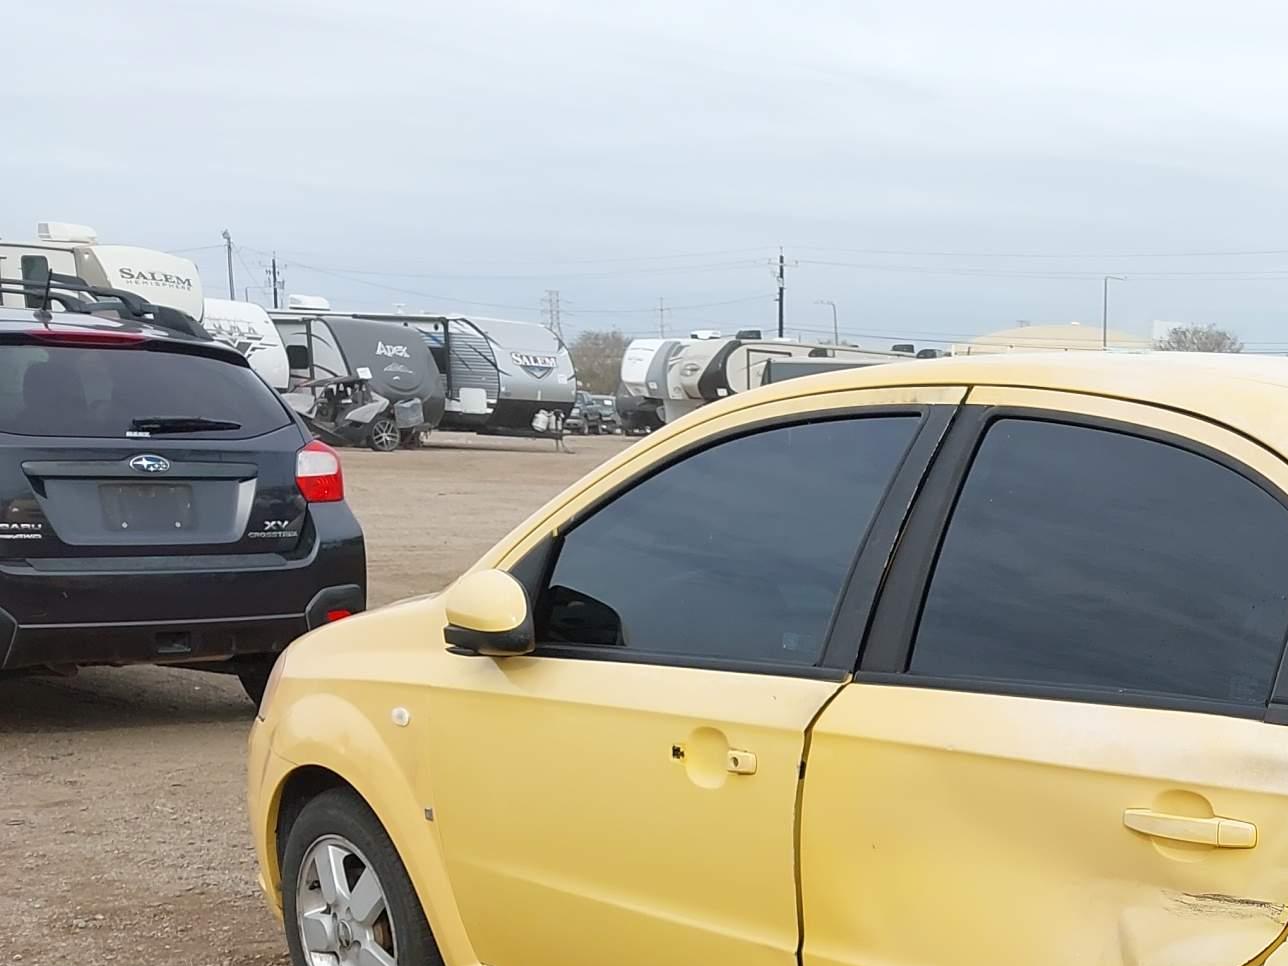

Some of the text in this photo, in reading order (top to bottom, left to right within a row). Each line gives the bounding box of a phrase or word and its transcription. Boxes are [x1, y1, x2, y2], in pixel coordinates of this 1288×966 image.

[119, 266, 192, 288] SALEM
[511, 352, 557, 368] SALEM
[264, 520, 289, 531] XV
